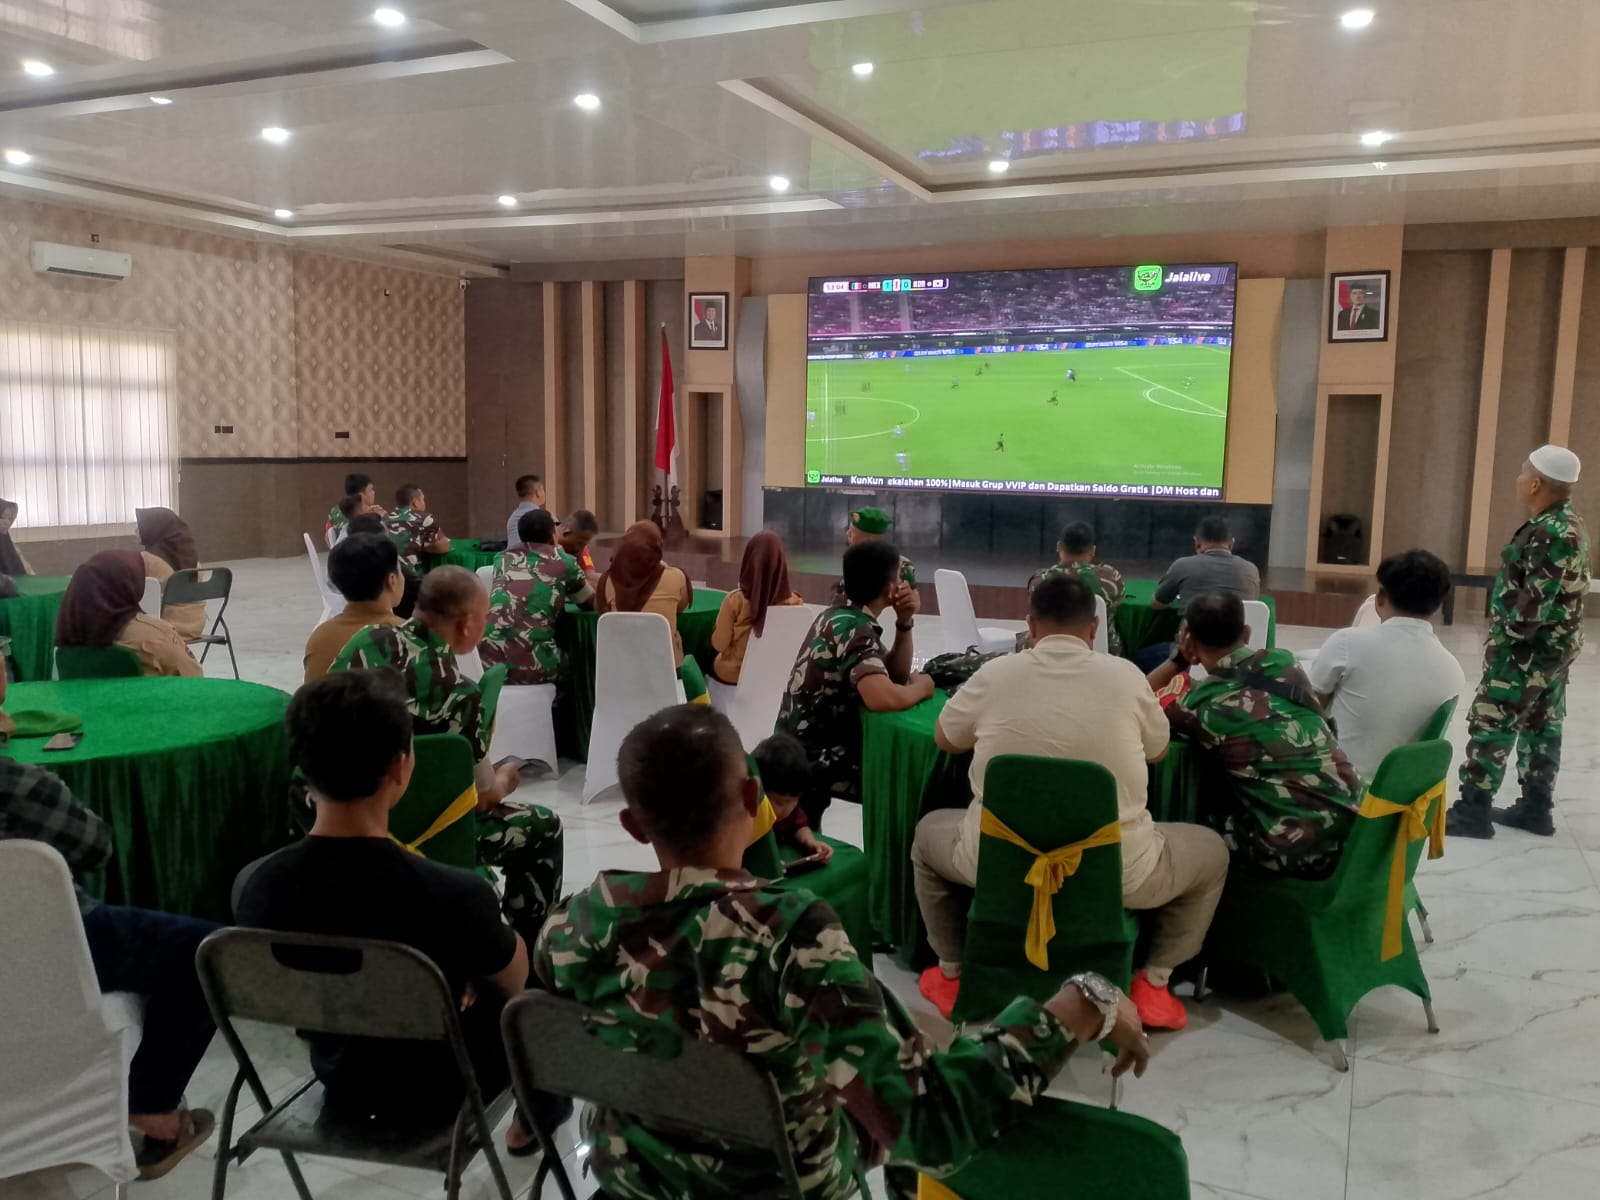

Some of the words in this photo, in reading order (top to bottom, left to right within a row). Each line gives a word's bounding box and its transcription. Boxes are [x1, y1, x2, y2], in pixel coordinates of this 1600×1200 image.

[1164, 271, 1212, 283] Jalalive
[850, 475, 884, 486] KunKun
[982, 480, 1004, 491] Grup
[1005, 480, 1027, 490] VVIP
[1028, 481, 1046, 491] dan
[1047, 482, 1091, 493] Dapatkan
[1092, 483, 1119, 493] Saldo
[1120, 484, 1149, 494] Gratis
[1175, 486, 1199, 495] Host
[1200, 487, 1219, 496] dan
